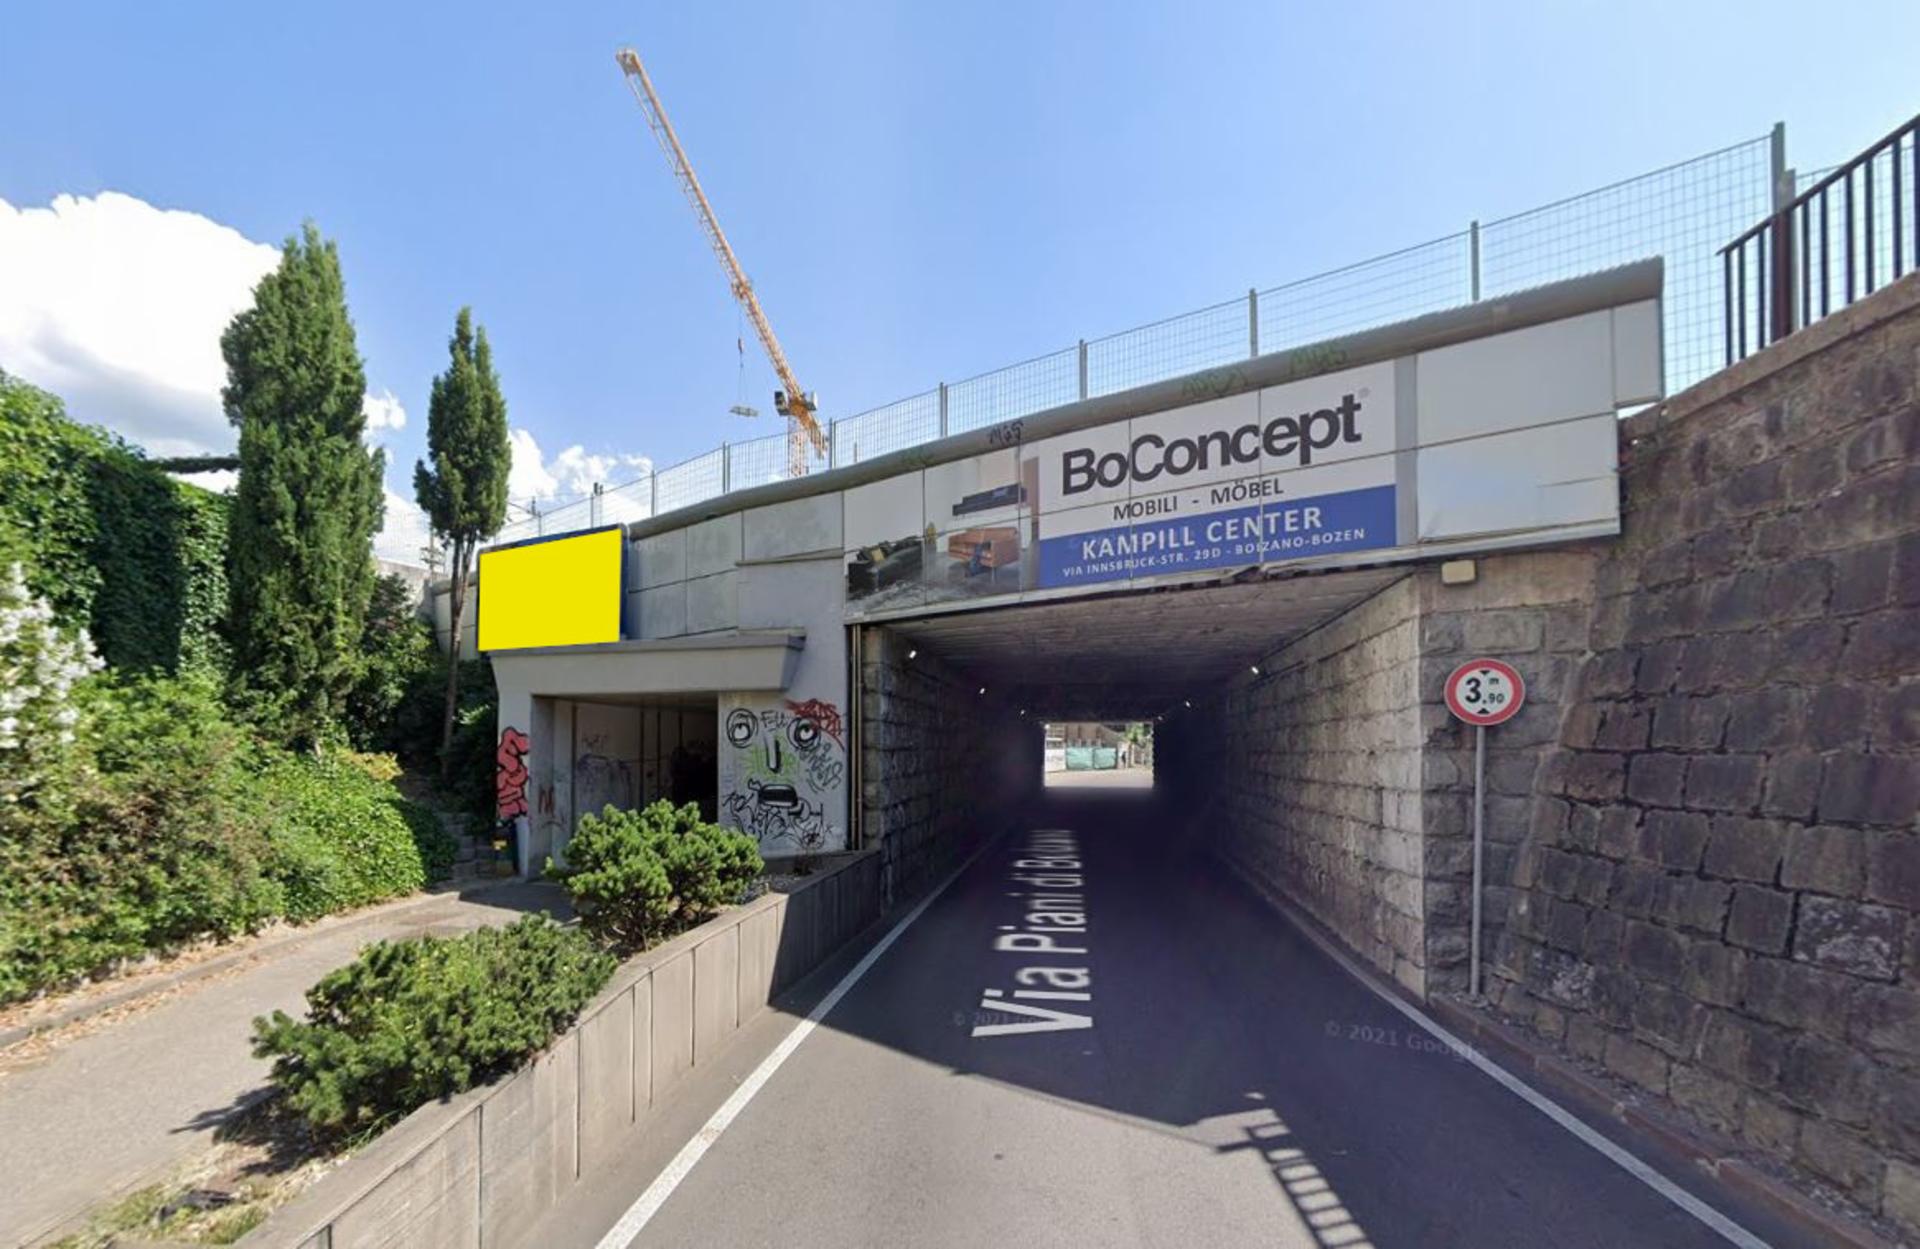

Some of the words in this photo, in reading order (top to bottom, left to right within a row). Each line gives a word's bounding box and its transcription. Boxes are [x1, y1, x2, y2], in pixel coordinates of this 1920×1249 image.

[1062, 394, 1362, 496] BoConcept
[1113, 495, 1178, 520] MOBILI
[1210, 477, 1284, 505] MÖBEL
[1082, 526, 1195, 561] KAMPILL
[1206, 506, 1323, 543] CENTER
[1062, 566, 1084, 577] VIA
